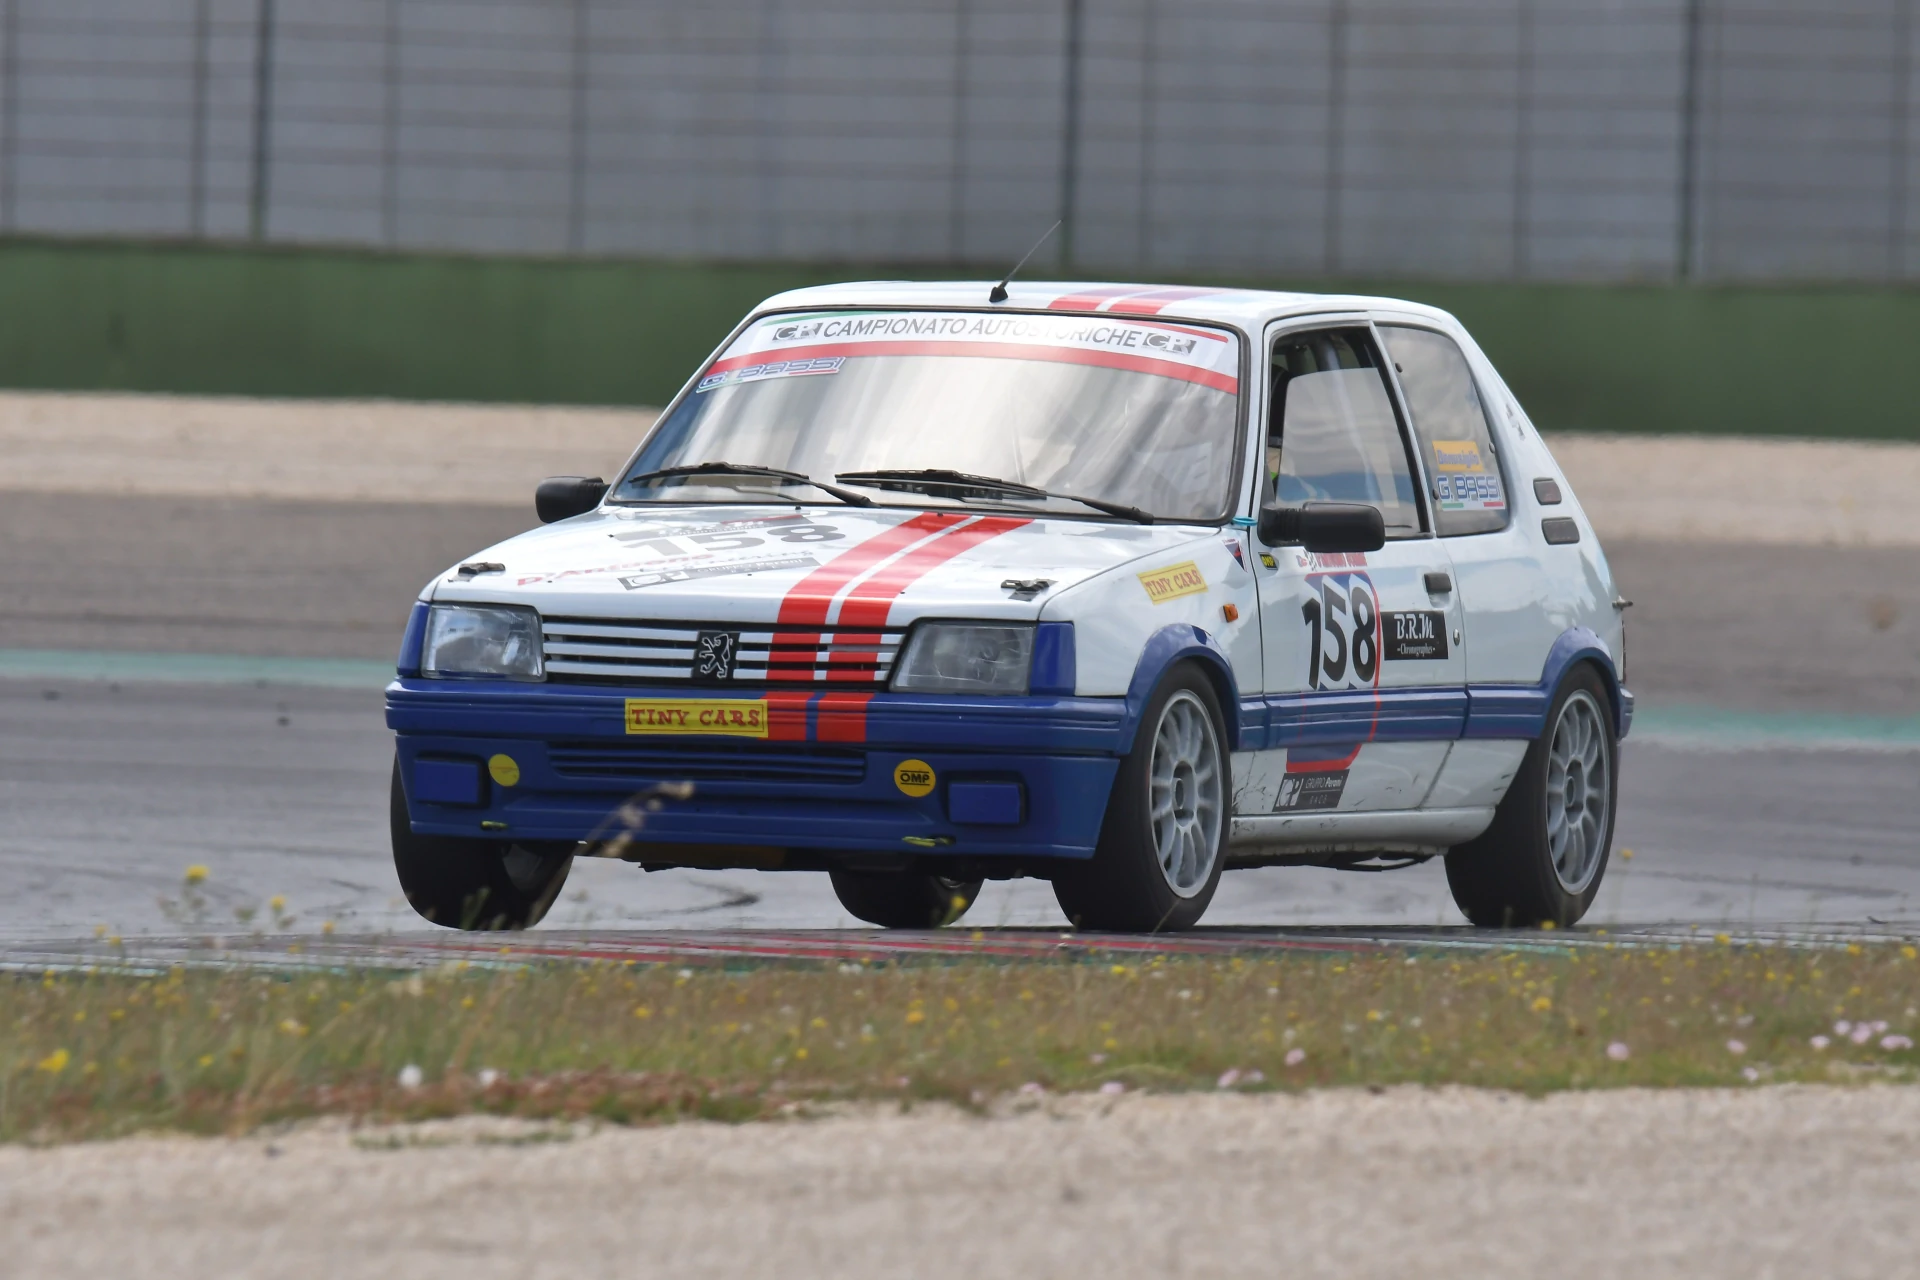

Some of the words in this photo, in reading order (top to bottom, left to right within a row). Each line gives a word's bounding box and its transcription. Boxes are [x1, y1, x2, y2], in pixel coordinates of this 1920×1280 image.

[824, 318, 967, 338] CAMPIONATO
[968, 318, 1144, 348] AUTOSTORICHE
[738, 357, 846, 378] BASSI
[1437, 476, 1454, 501] G.
[623, 525, 846, 557] 158
[1145, 579, 1173, 597] TINY
[1173, 569, 1202, 590] CARS
[1302, 584, 1376, 691] 158
[631, 709, 690, 726] TINY
[699, 709, 761, 727] CARS
[900, 773, 930, 785] OMP
